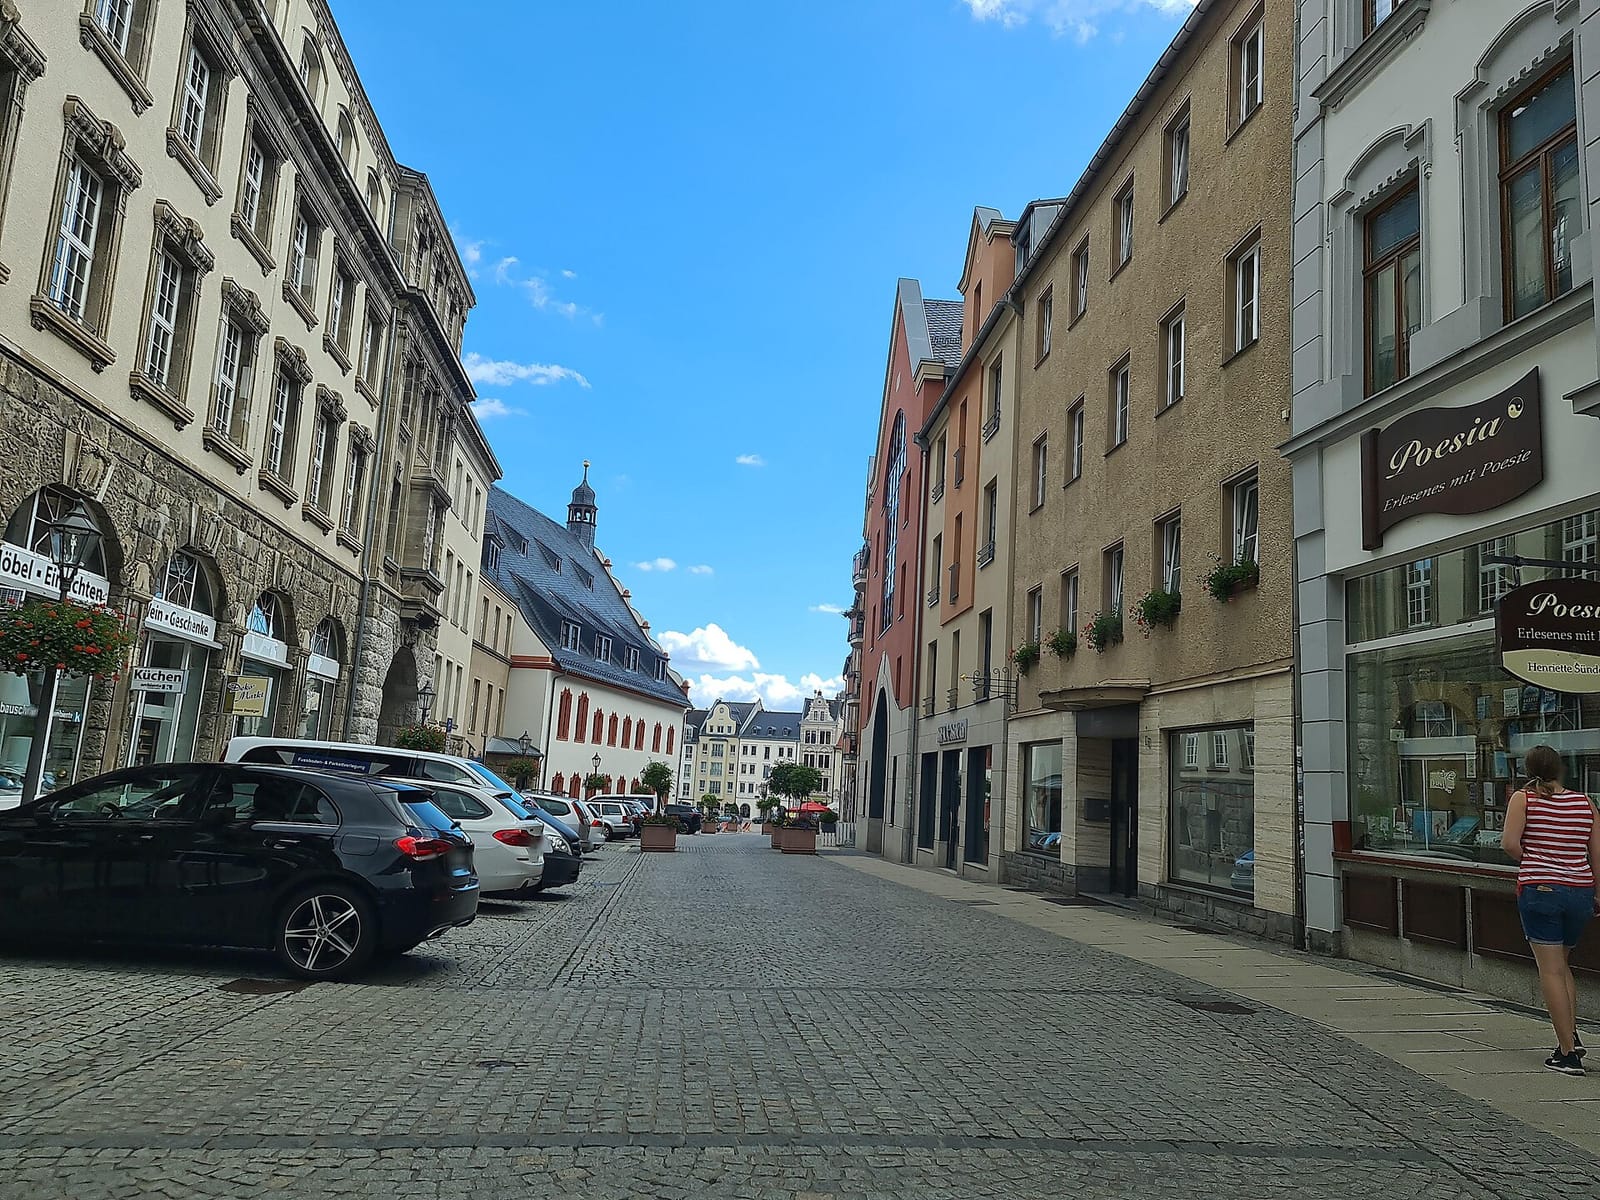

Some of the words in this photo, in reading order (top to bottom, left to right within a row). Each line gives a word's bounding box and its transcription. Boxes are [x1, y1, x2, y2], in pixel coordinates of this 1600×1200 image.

[1385, 417, 1506, 480] Poesia
[1383, 481, 1446, 512] Erlesenes
[1449, 468, 1476, 489] mit
[1479, 449, 1532, 478] Poesie
[0, 550, 34, 580] öbel
[147, 604, 164, 622] ein
[169, 611, 209, 637] Geschenke
[1517, 627, 1573, 640] Erlesenes
[1575, 630, 1595, 641] mit
[134, 669, 182, 683] Küchen
[1527, 662, 1572, 673] Henriette
